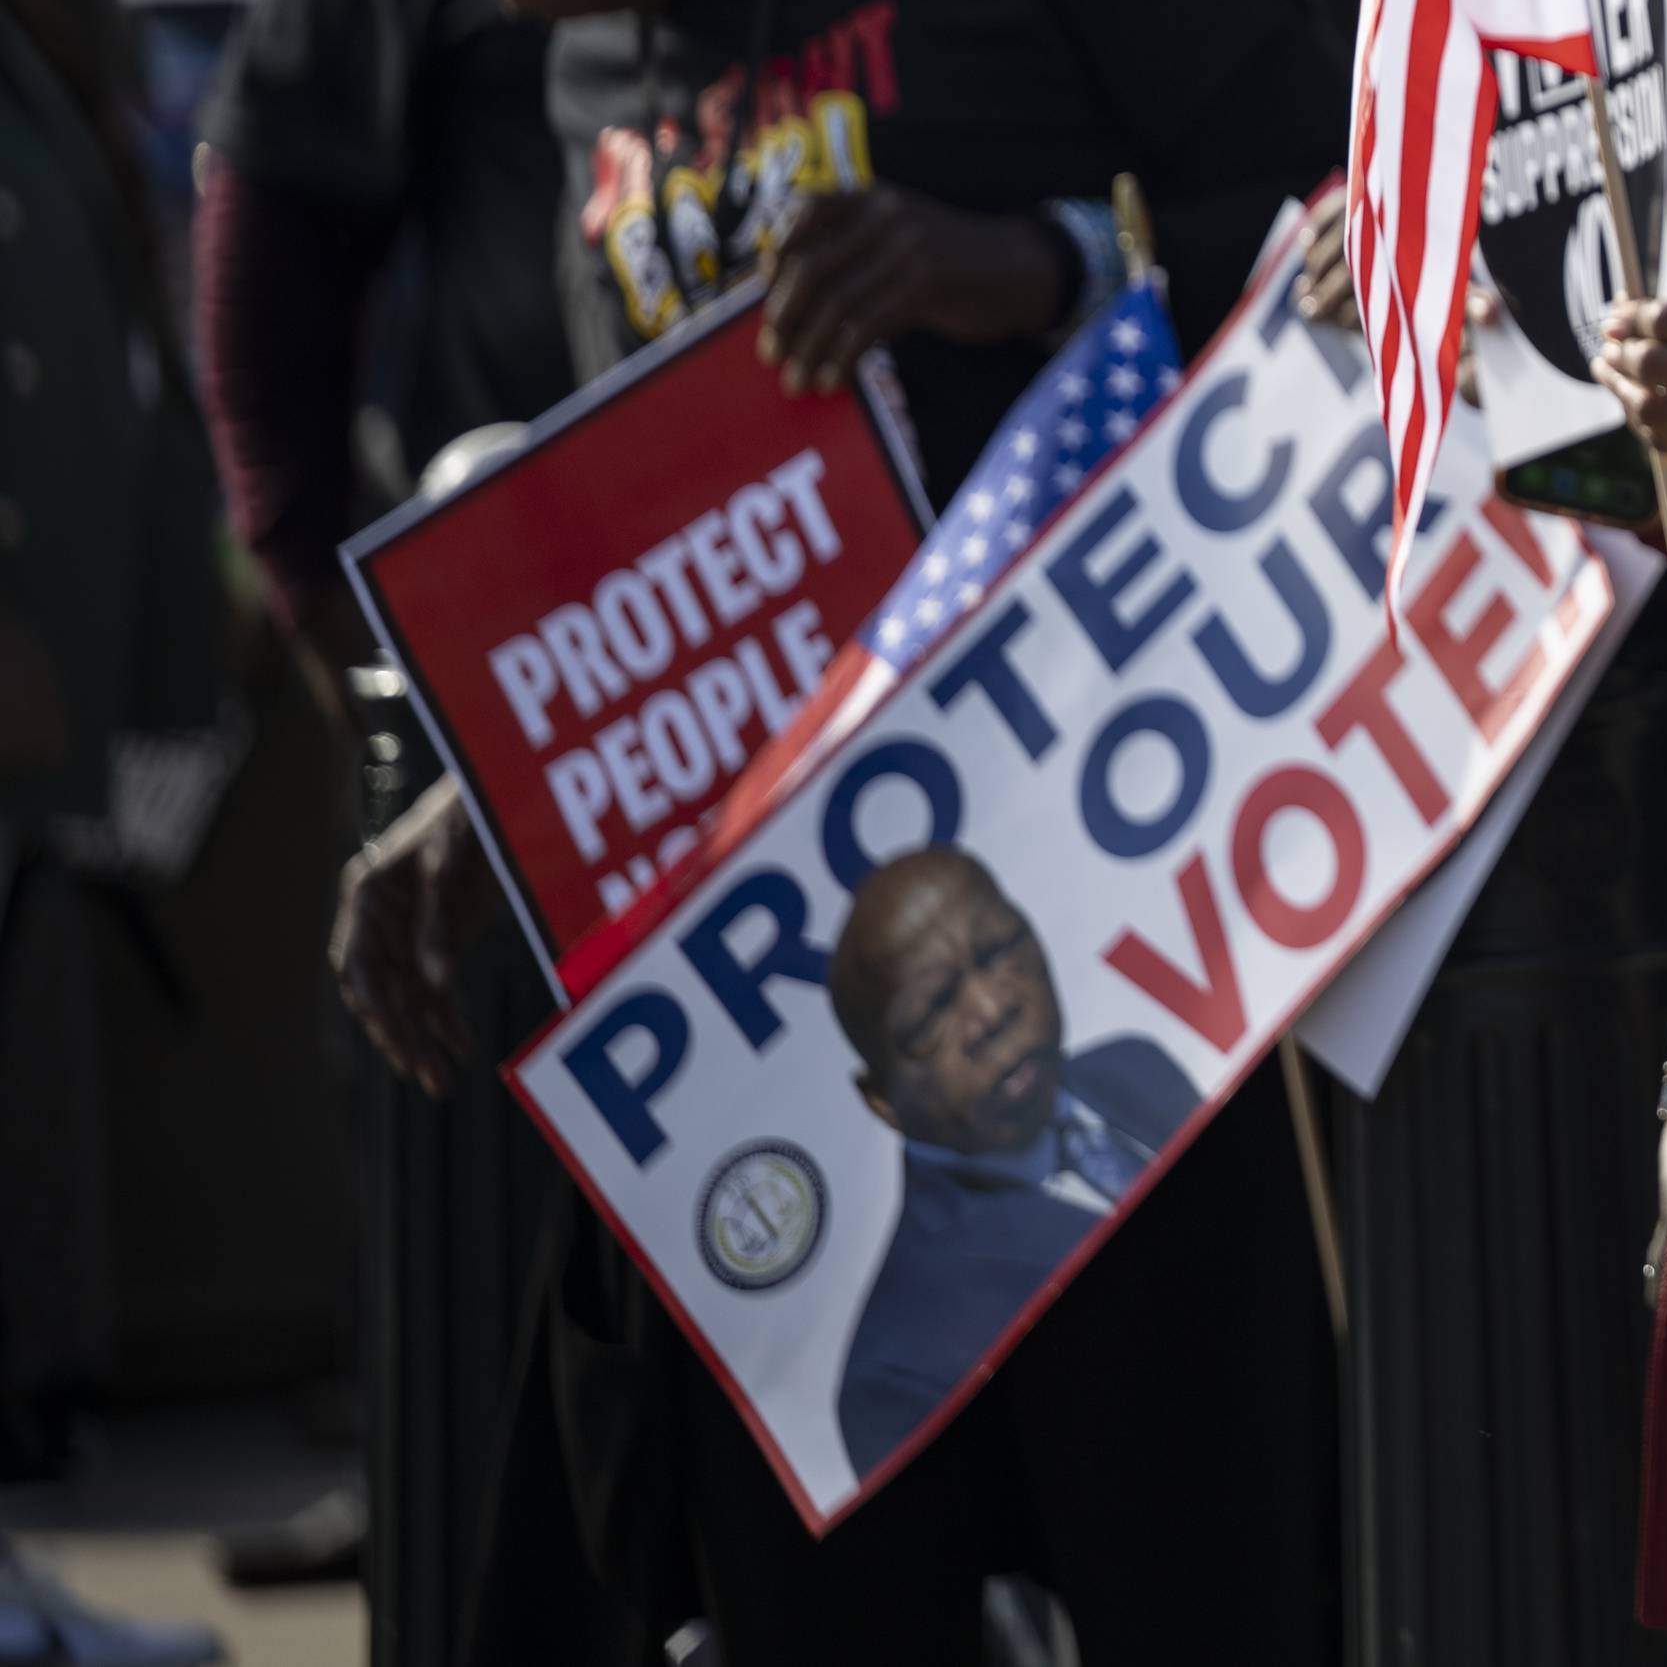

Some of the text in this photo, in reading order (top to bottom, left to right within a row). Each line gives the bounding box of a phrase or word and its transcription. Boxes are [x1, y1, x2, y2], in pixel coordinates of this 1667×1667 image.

[487, 447, 844, 751] PROTECT
[544, 599, 837, 865] PEOPLE
[1078, 420, 1448, 862] OUR
